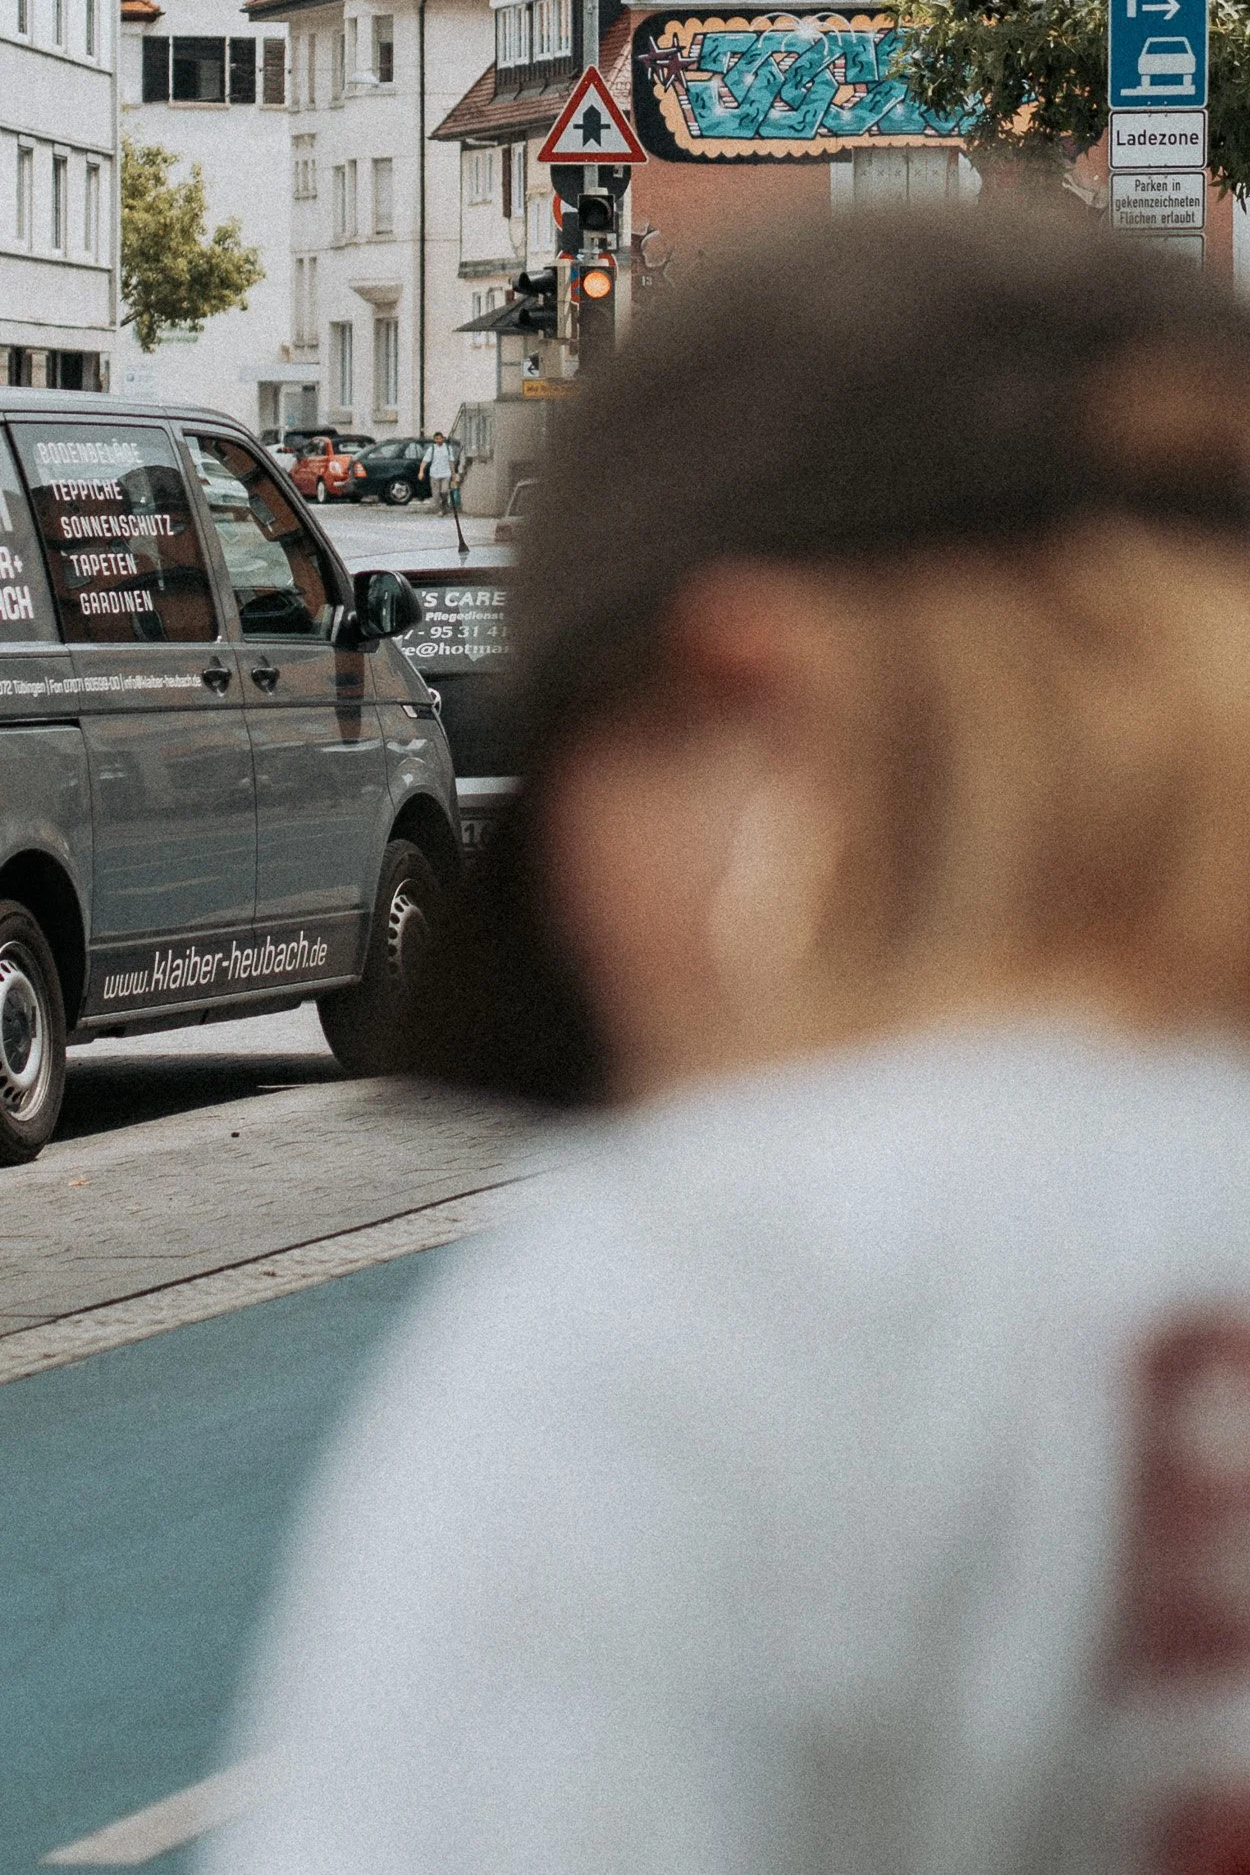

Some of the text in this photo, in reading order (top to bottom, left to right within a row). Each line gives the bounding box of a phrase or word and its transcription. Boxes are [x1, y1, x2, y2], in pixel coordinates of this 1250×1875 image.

[1116, 129, 1199, 146] Ladezone
[1134, 178, 1181, 192] Parken in
[1115, 195, 1200, 212] gekennzeichneten
[1119, 211, 1196, 225] Flächen erlaubt
[50, 478, 123, 501] TEPPICHE
[60, 514, 175, 539] SONNENSCHUTZ
[69, 553, 138, 577] TAPETEN
[79, 590, 154, 615] GARDINEN
[444, 591, 508, 607] CARE
[425, 611, 504, 623] Pflegedienst
[430, 626, 453, 639] 95
[457, 626, 479, 638] 31
[103, 930, 328, 1000] www.klaiber-heubach.de
